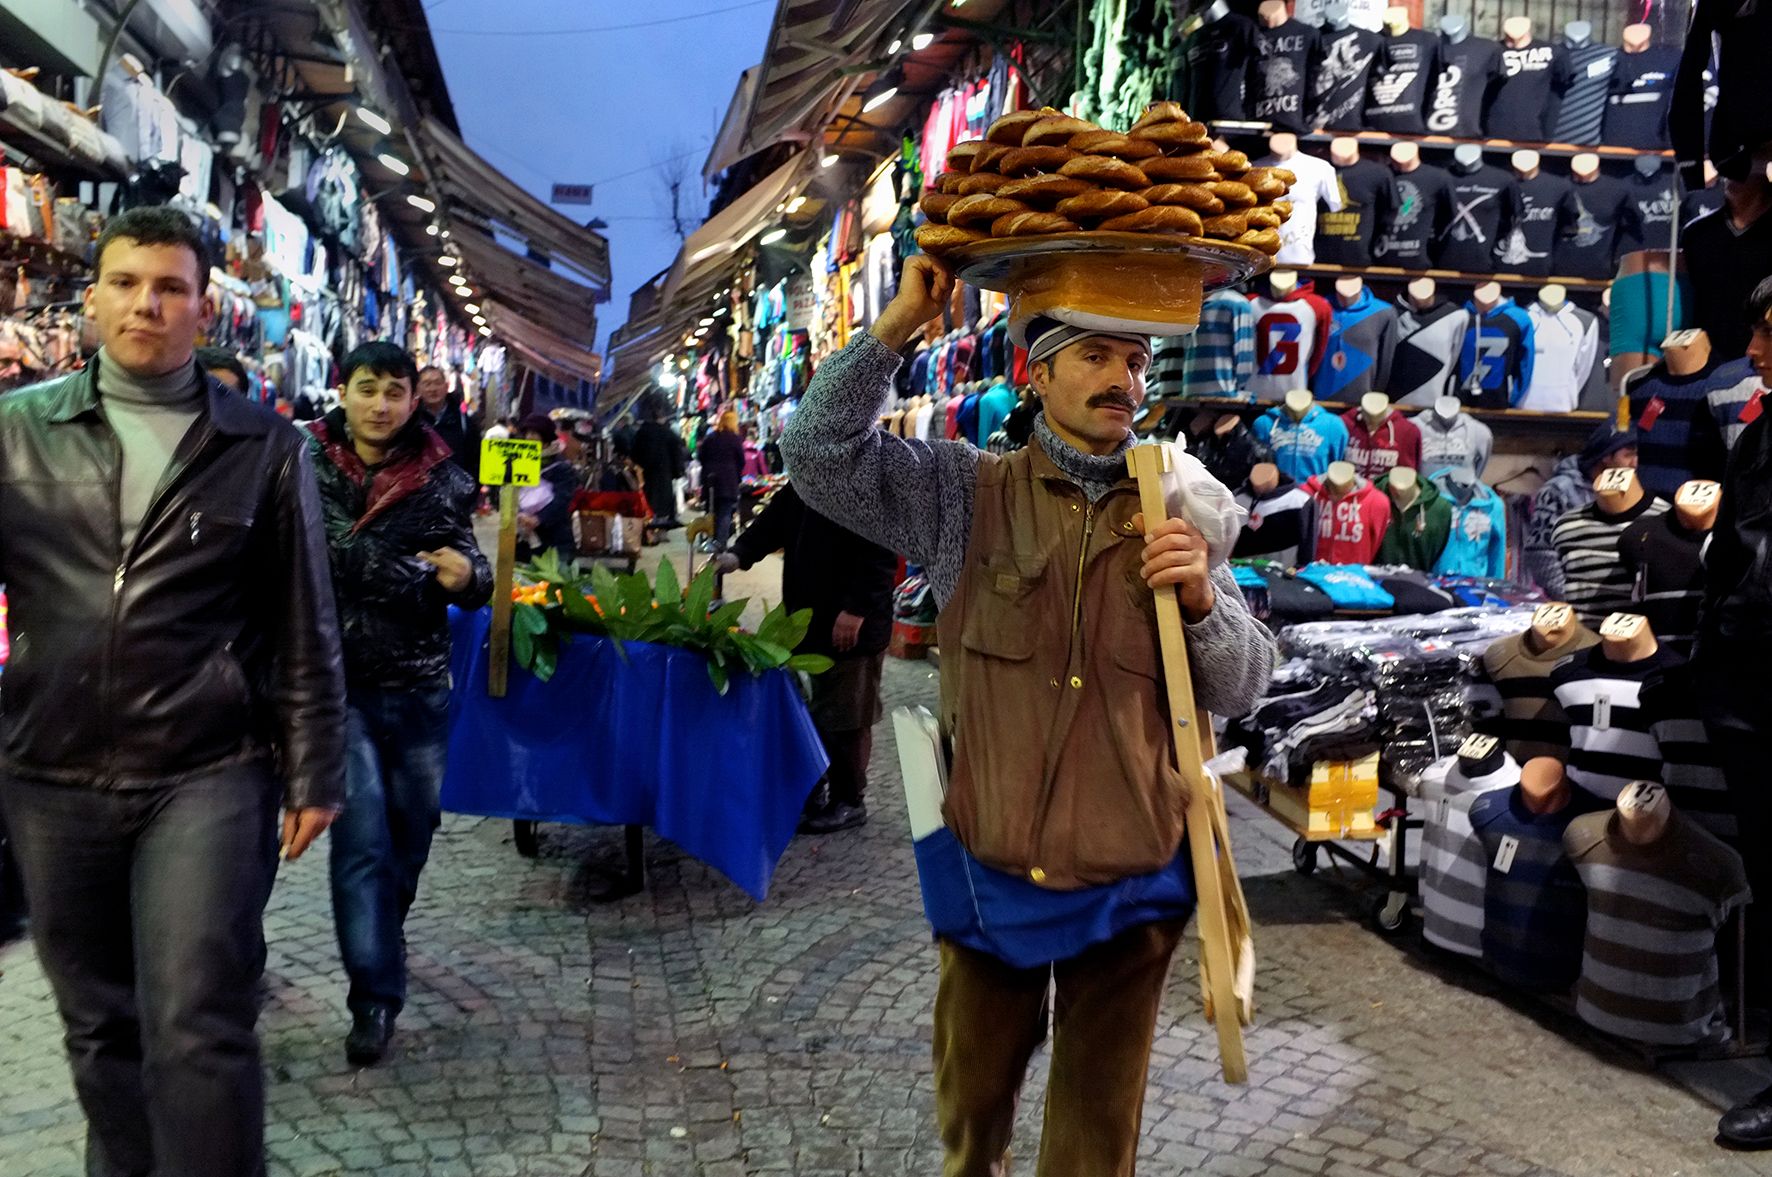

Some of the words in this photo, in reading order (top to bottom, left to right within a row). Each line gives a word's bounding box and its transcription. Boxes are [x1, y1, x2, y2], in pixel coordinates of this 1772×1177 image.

[1502, 46, 1553, 77] STAR
[1608, 469, 1631, 483] 15
[1691, 483, 1716, 497] 15
[1541, 605, 1566, 619] 15
[1614, 614, 1634, 628] 15
[1634, 783, 1661, 803] 15
